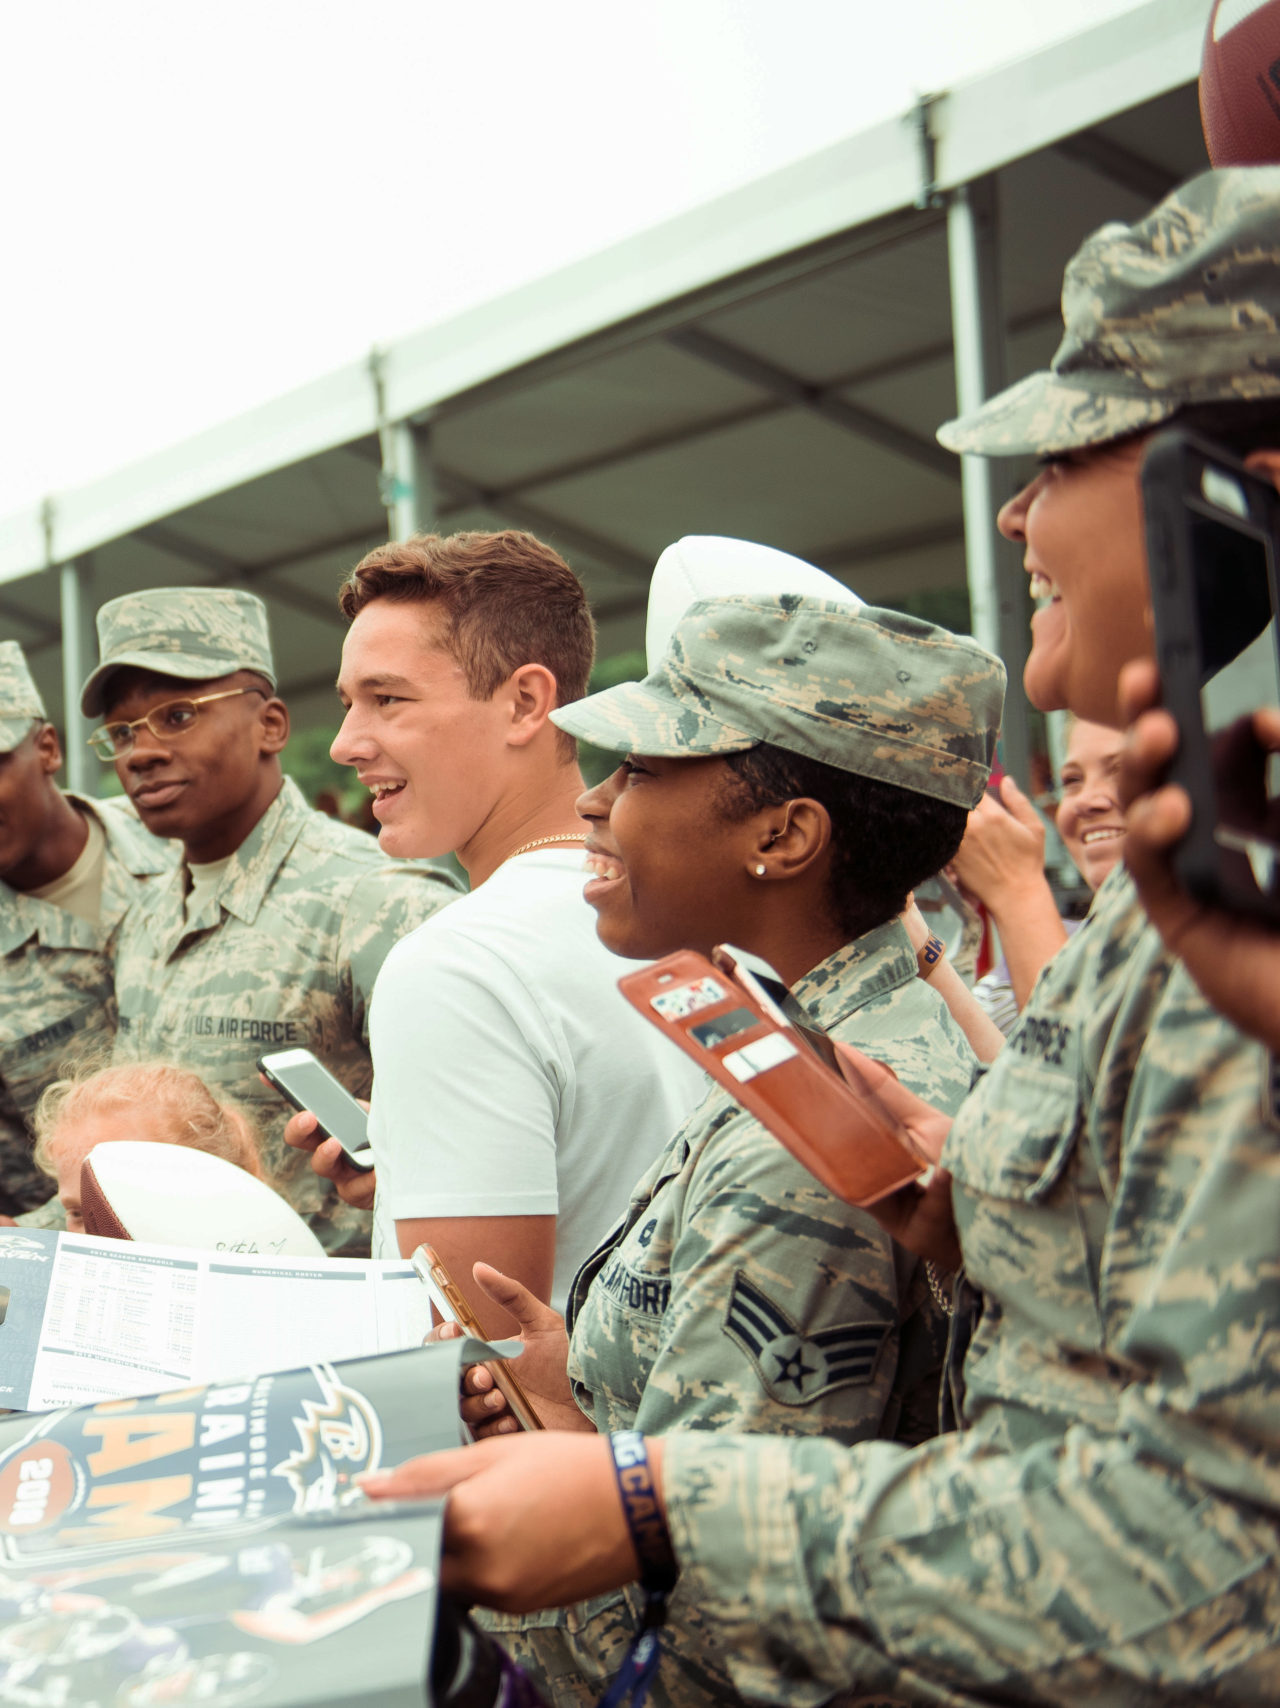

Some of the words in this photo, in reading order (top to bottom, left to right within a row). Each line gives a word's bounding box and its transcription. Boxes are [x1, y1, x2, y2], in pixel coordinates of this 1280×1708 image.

[194, 1017, 215, 1036] U.S.
[218, 1019, 240, 1041] AIR
[240, 1019, 298, 1042] FORCE
